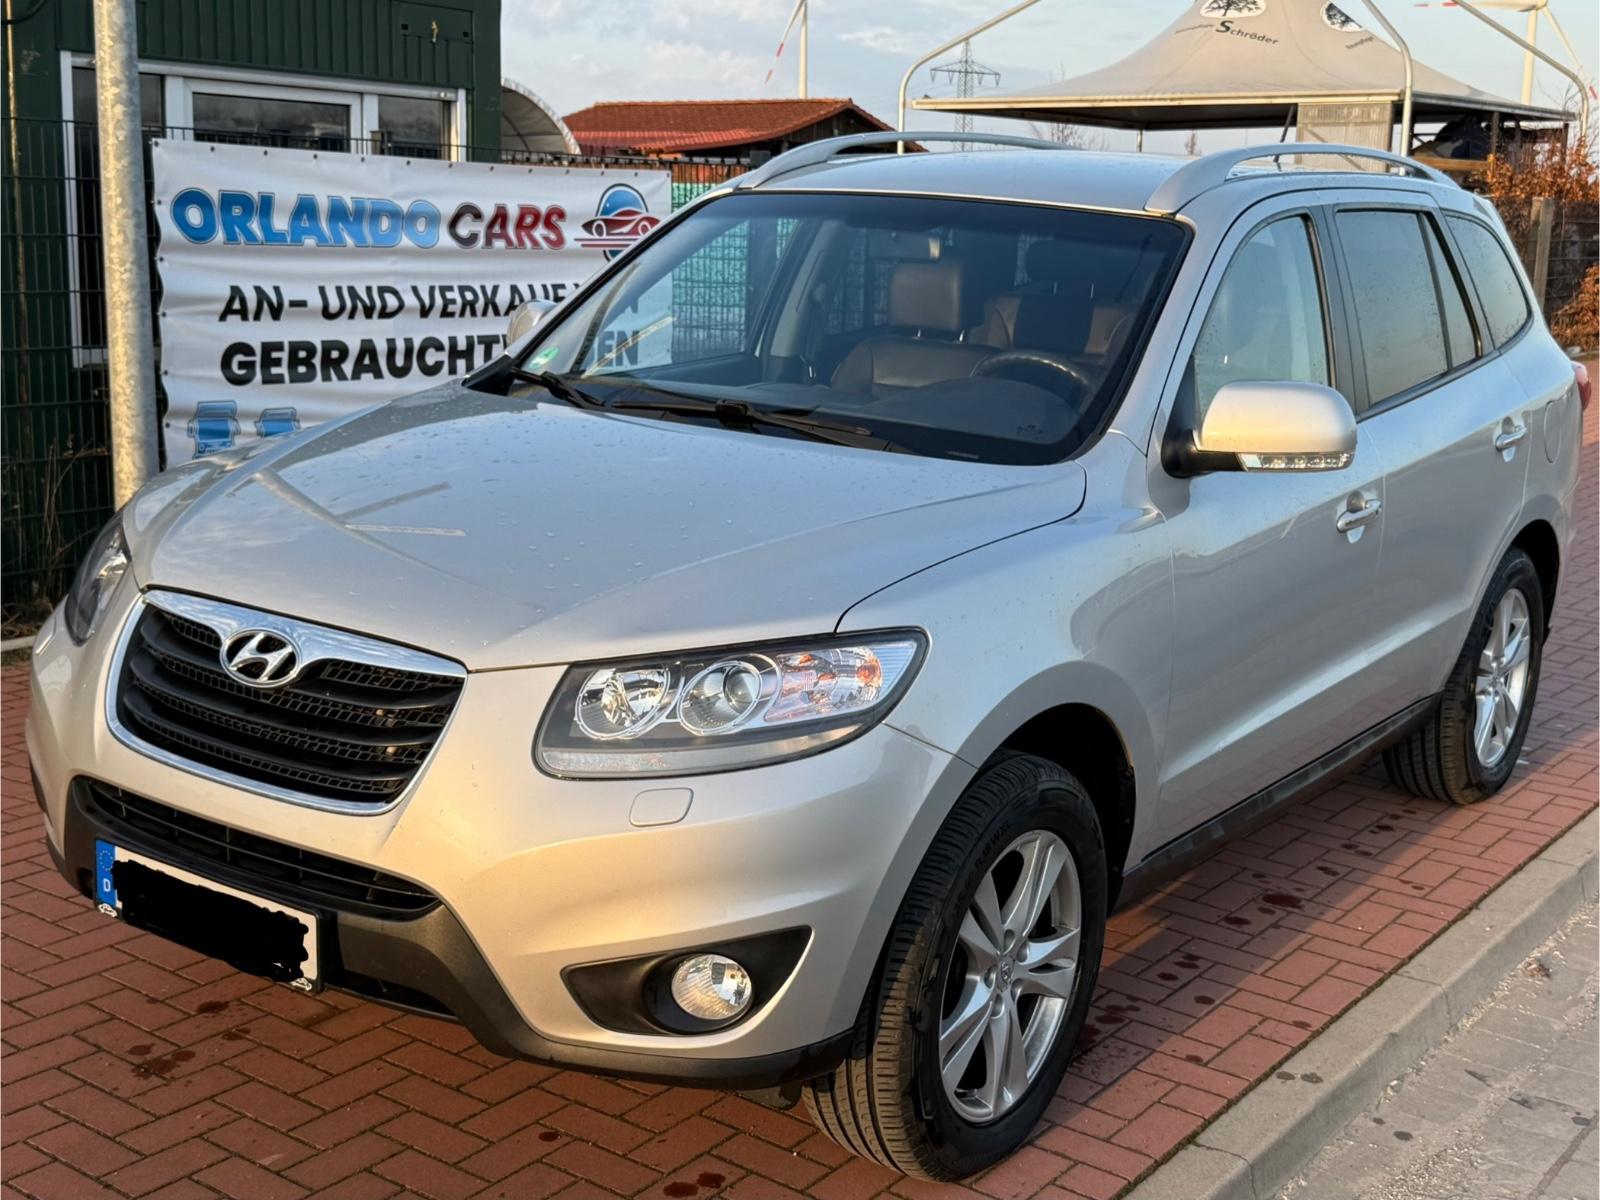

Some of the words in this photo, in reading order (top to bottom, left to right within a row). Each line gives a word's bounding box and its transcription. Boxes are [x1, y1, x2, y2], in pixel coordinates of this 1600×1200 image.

[1215, 20, 1279, 45] Schröder
[170, 187, 441, 249] ORLANDO
[448, 202, 568, 250] CARS
[218, 285, 308, 322] AN-
[318, 285, 406, 321] UND
[103, 877, 111, 892] D
